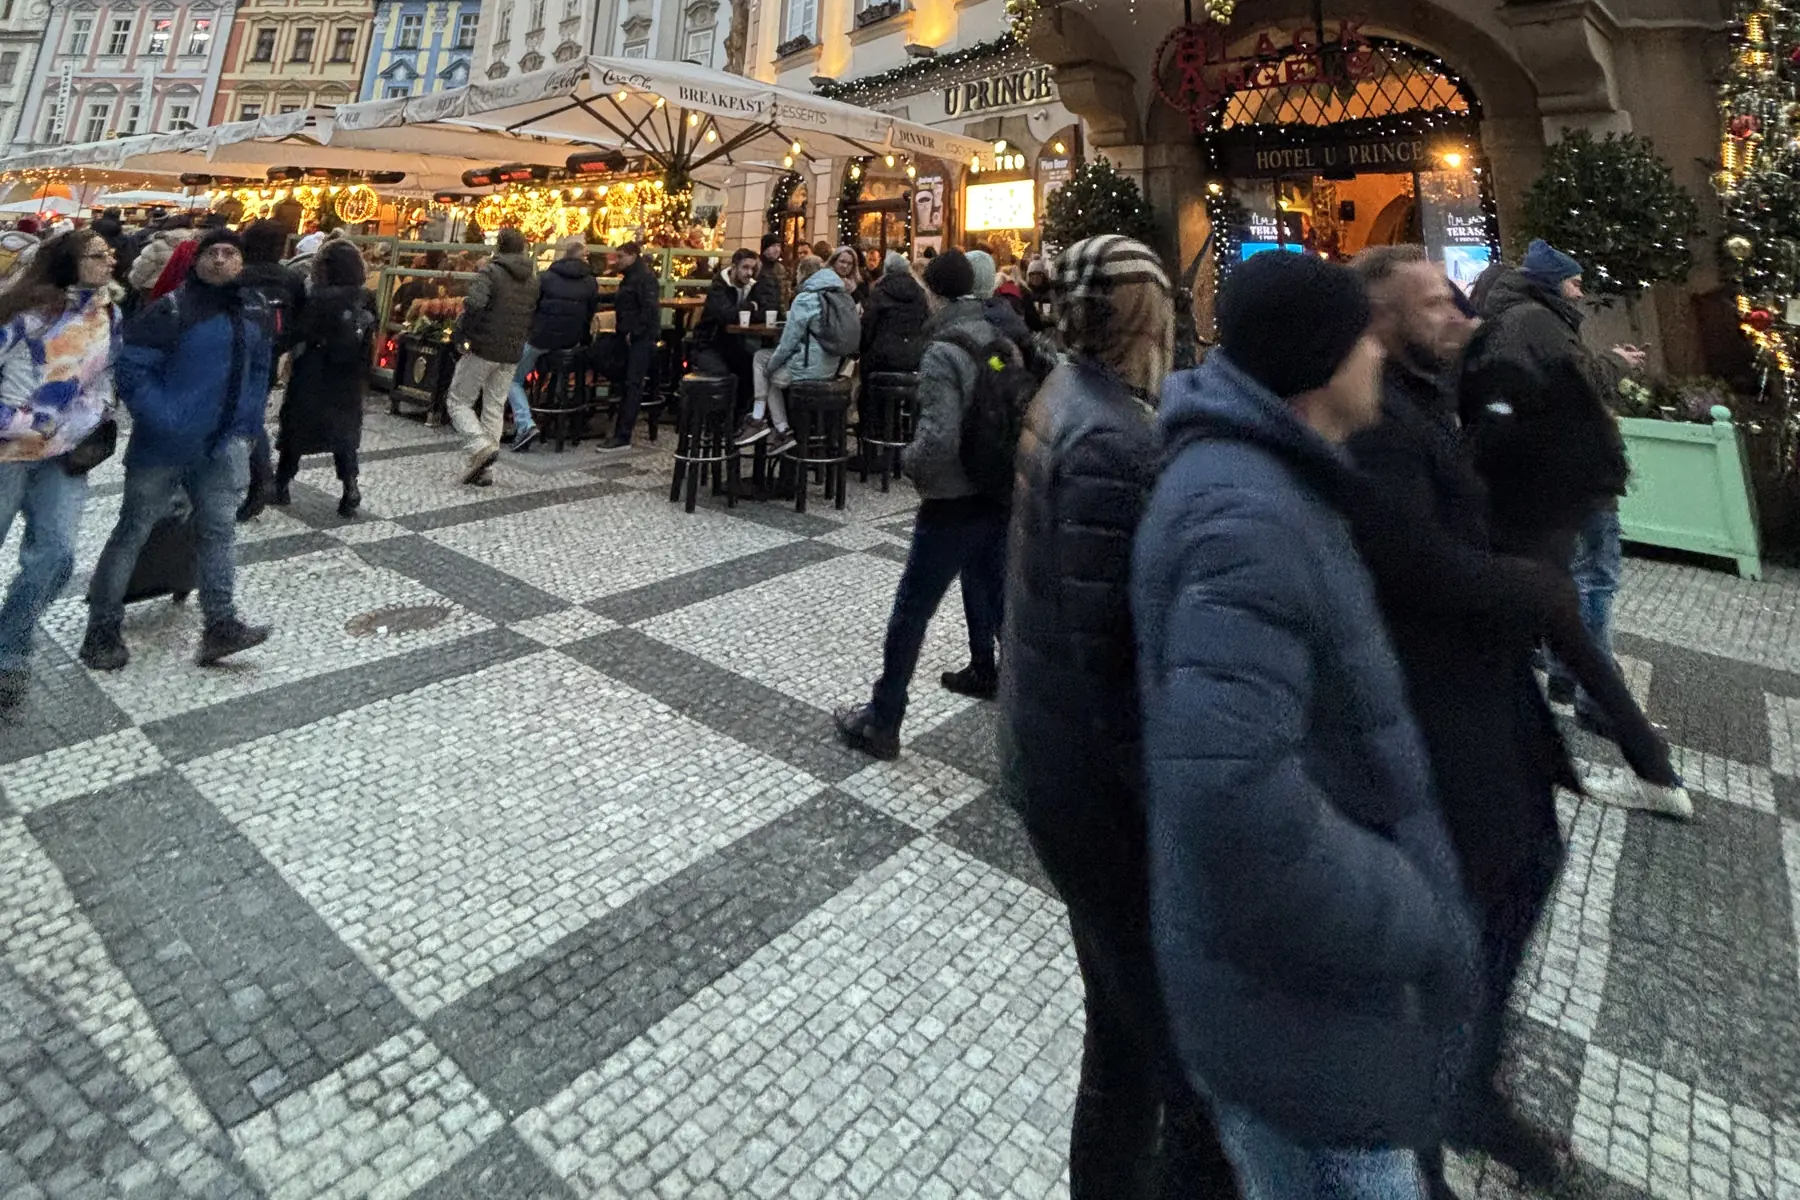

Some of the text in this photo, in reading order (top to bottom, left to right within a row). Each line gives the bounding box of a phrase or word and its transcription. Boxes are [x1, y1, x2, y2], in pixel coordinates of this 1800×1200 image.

[679, 86, 765, 113] BREAKFAST
[944, 67, 1053, 115] U PRINCE
[776, 104, 828, 125] DESSERTS
[899, 130, 935, 149] DINNER
[1256, 140, 1424, 169] HOTEL U PRINCE
[1249, 225, 1291, 236] TERAA
